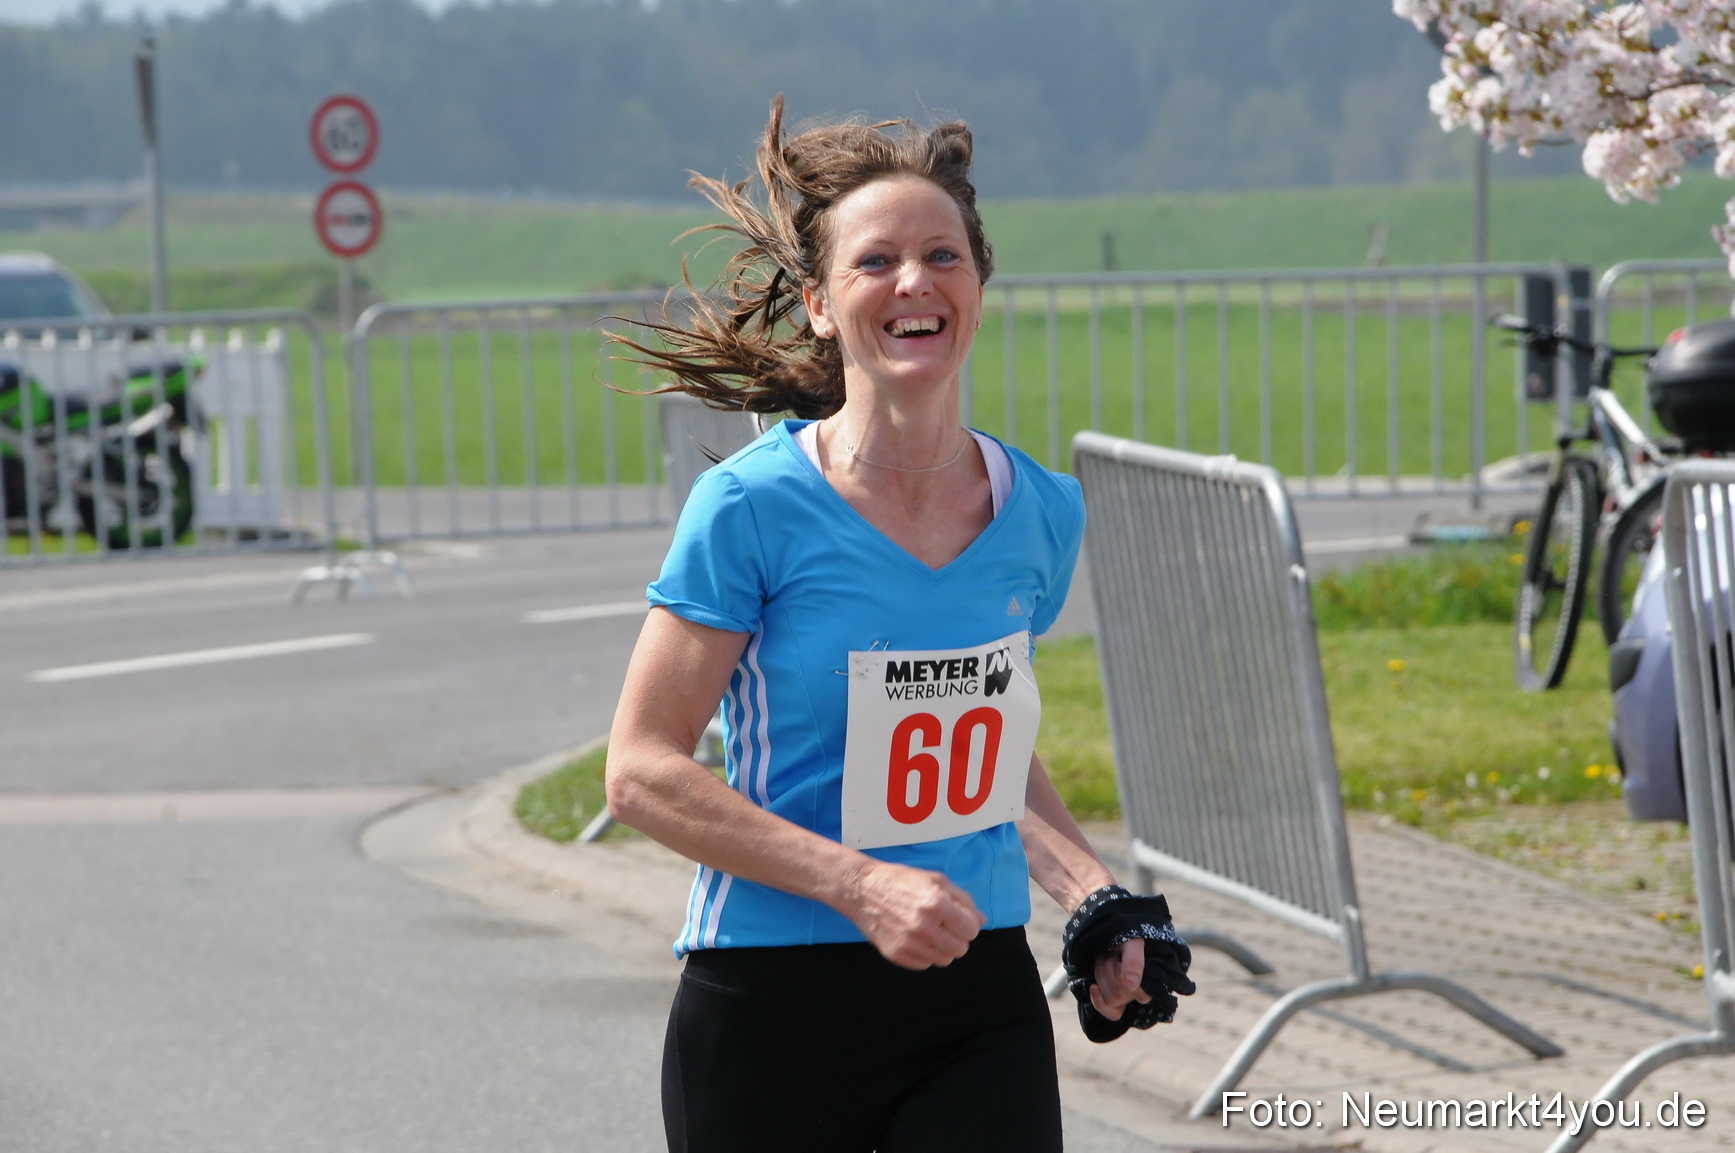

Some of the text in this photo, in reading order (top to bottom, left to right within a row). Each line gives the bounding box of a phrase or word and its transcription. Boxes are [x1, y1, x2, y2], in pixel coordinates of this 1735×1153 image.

[884, 656, 980, 683] MEYER
[885, 679, 979, 701] WERBUNG
[886, 706, 1003, 825] 60
